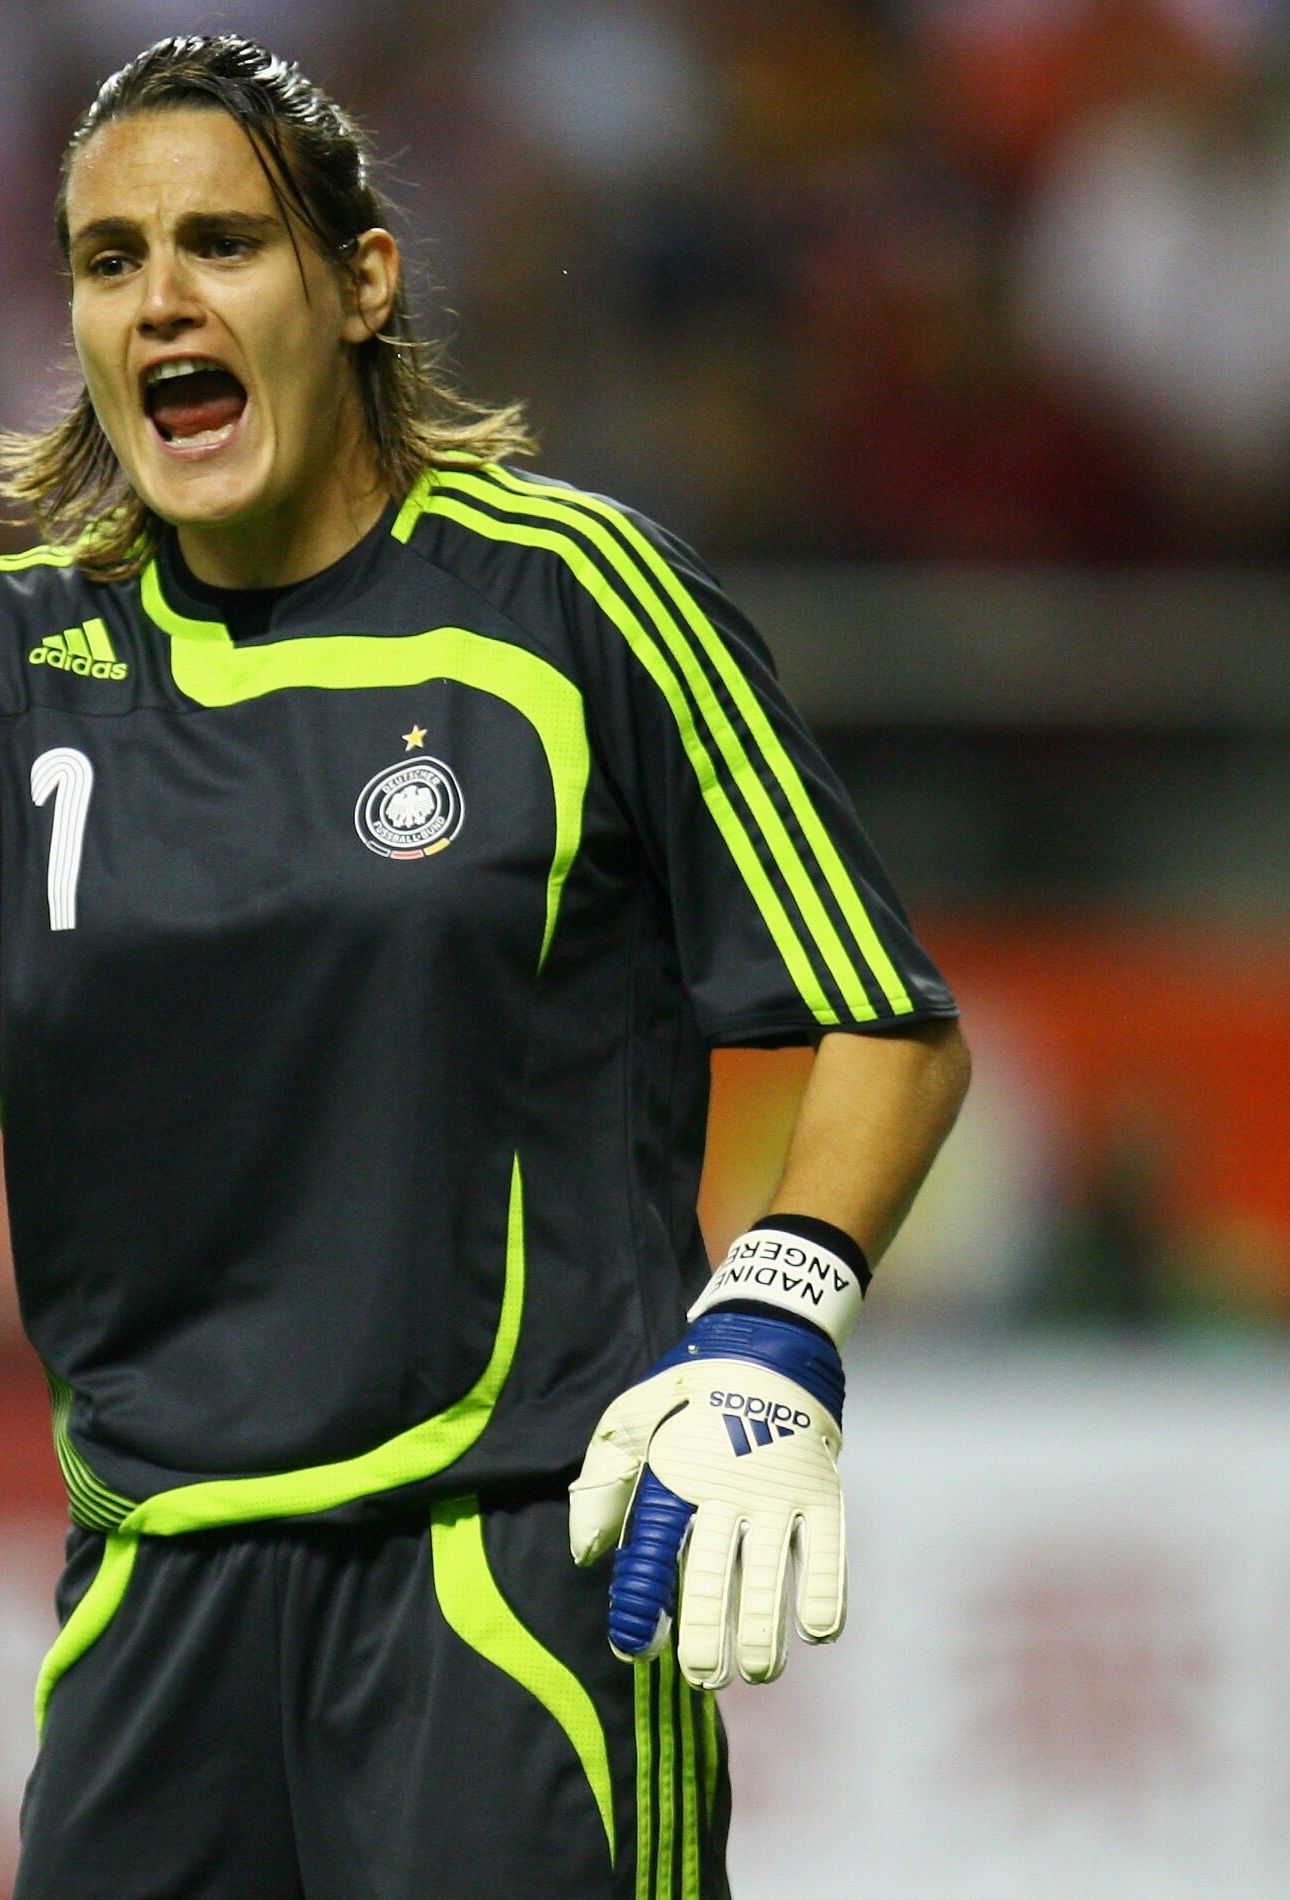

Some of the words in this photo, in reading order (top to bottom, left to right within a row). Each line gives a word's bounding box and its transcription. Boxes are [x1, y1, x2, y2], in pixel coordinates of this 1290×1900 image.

[29, 647, 128, 679] adidas
[382, 770, 440, 793] DEUTSCHER
[30, 747, 94, 931] 1
[709, 1265, 824, 1306] NADINE
[710, 1390, 811, 1429] adidas
